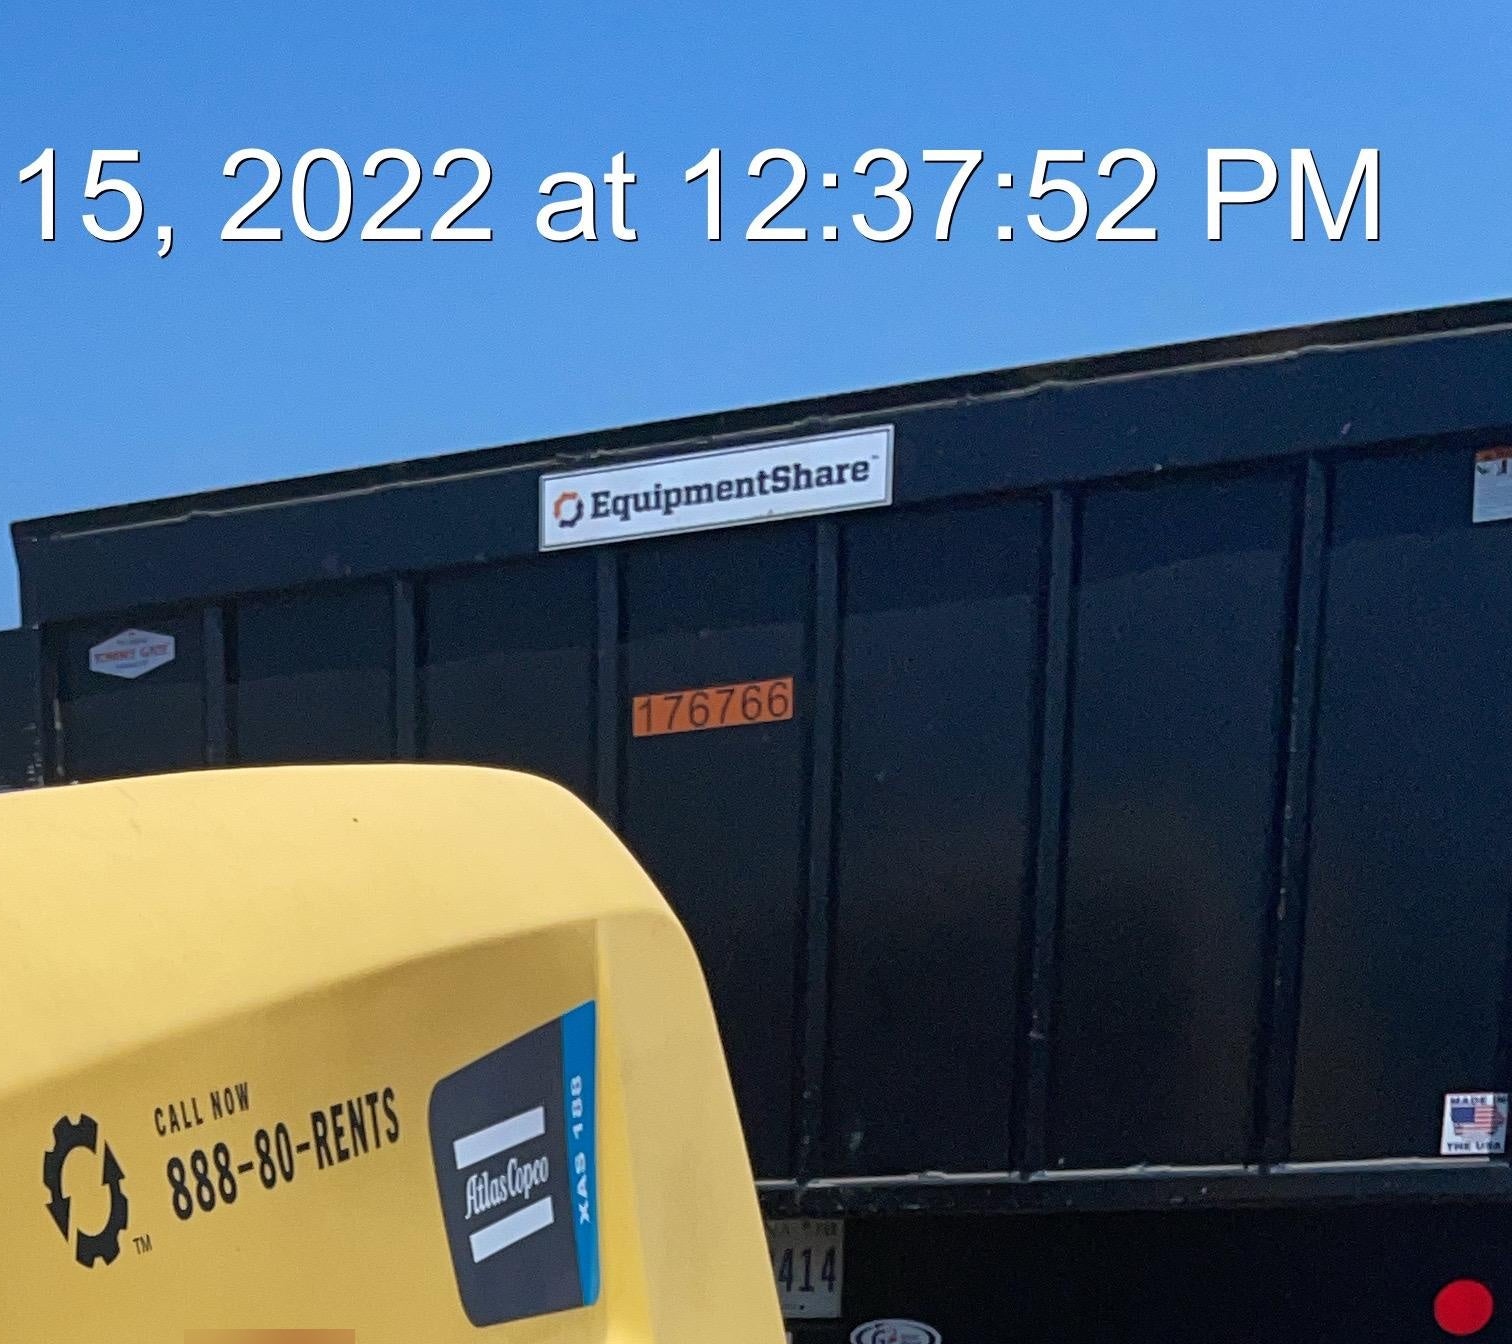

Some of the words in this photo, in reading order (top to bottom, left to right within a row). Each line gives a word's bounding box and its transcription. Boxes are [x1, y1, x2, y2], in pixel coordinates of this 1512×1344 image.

[590, 458, 870, 521] EquipmentShare
[637, 680, 789, 733] 176766
[154, 1097, 204, 1137] CALL
[209, 1081, 250, 1121] NOW
[570, 1075, 584, 1140] 188
[166, 1086, 400, 1221] 888-80-RENTS
